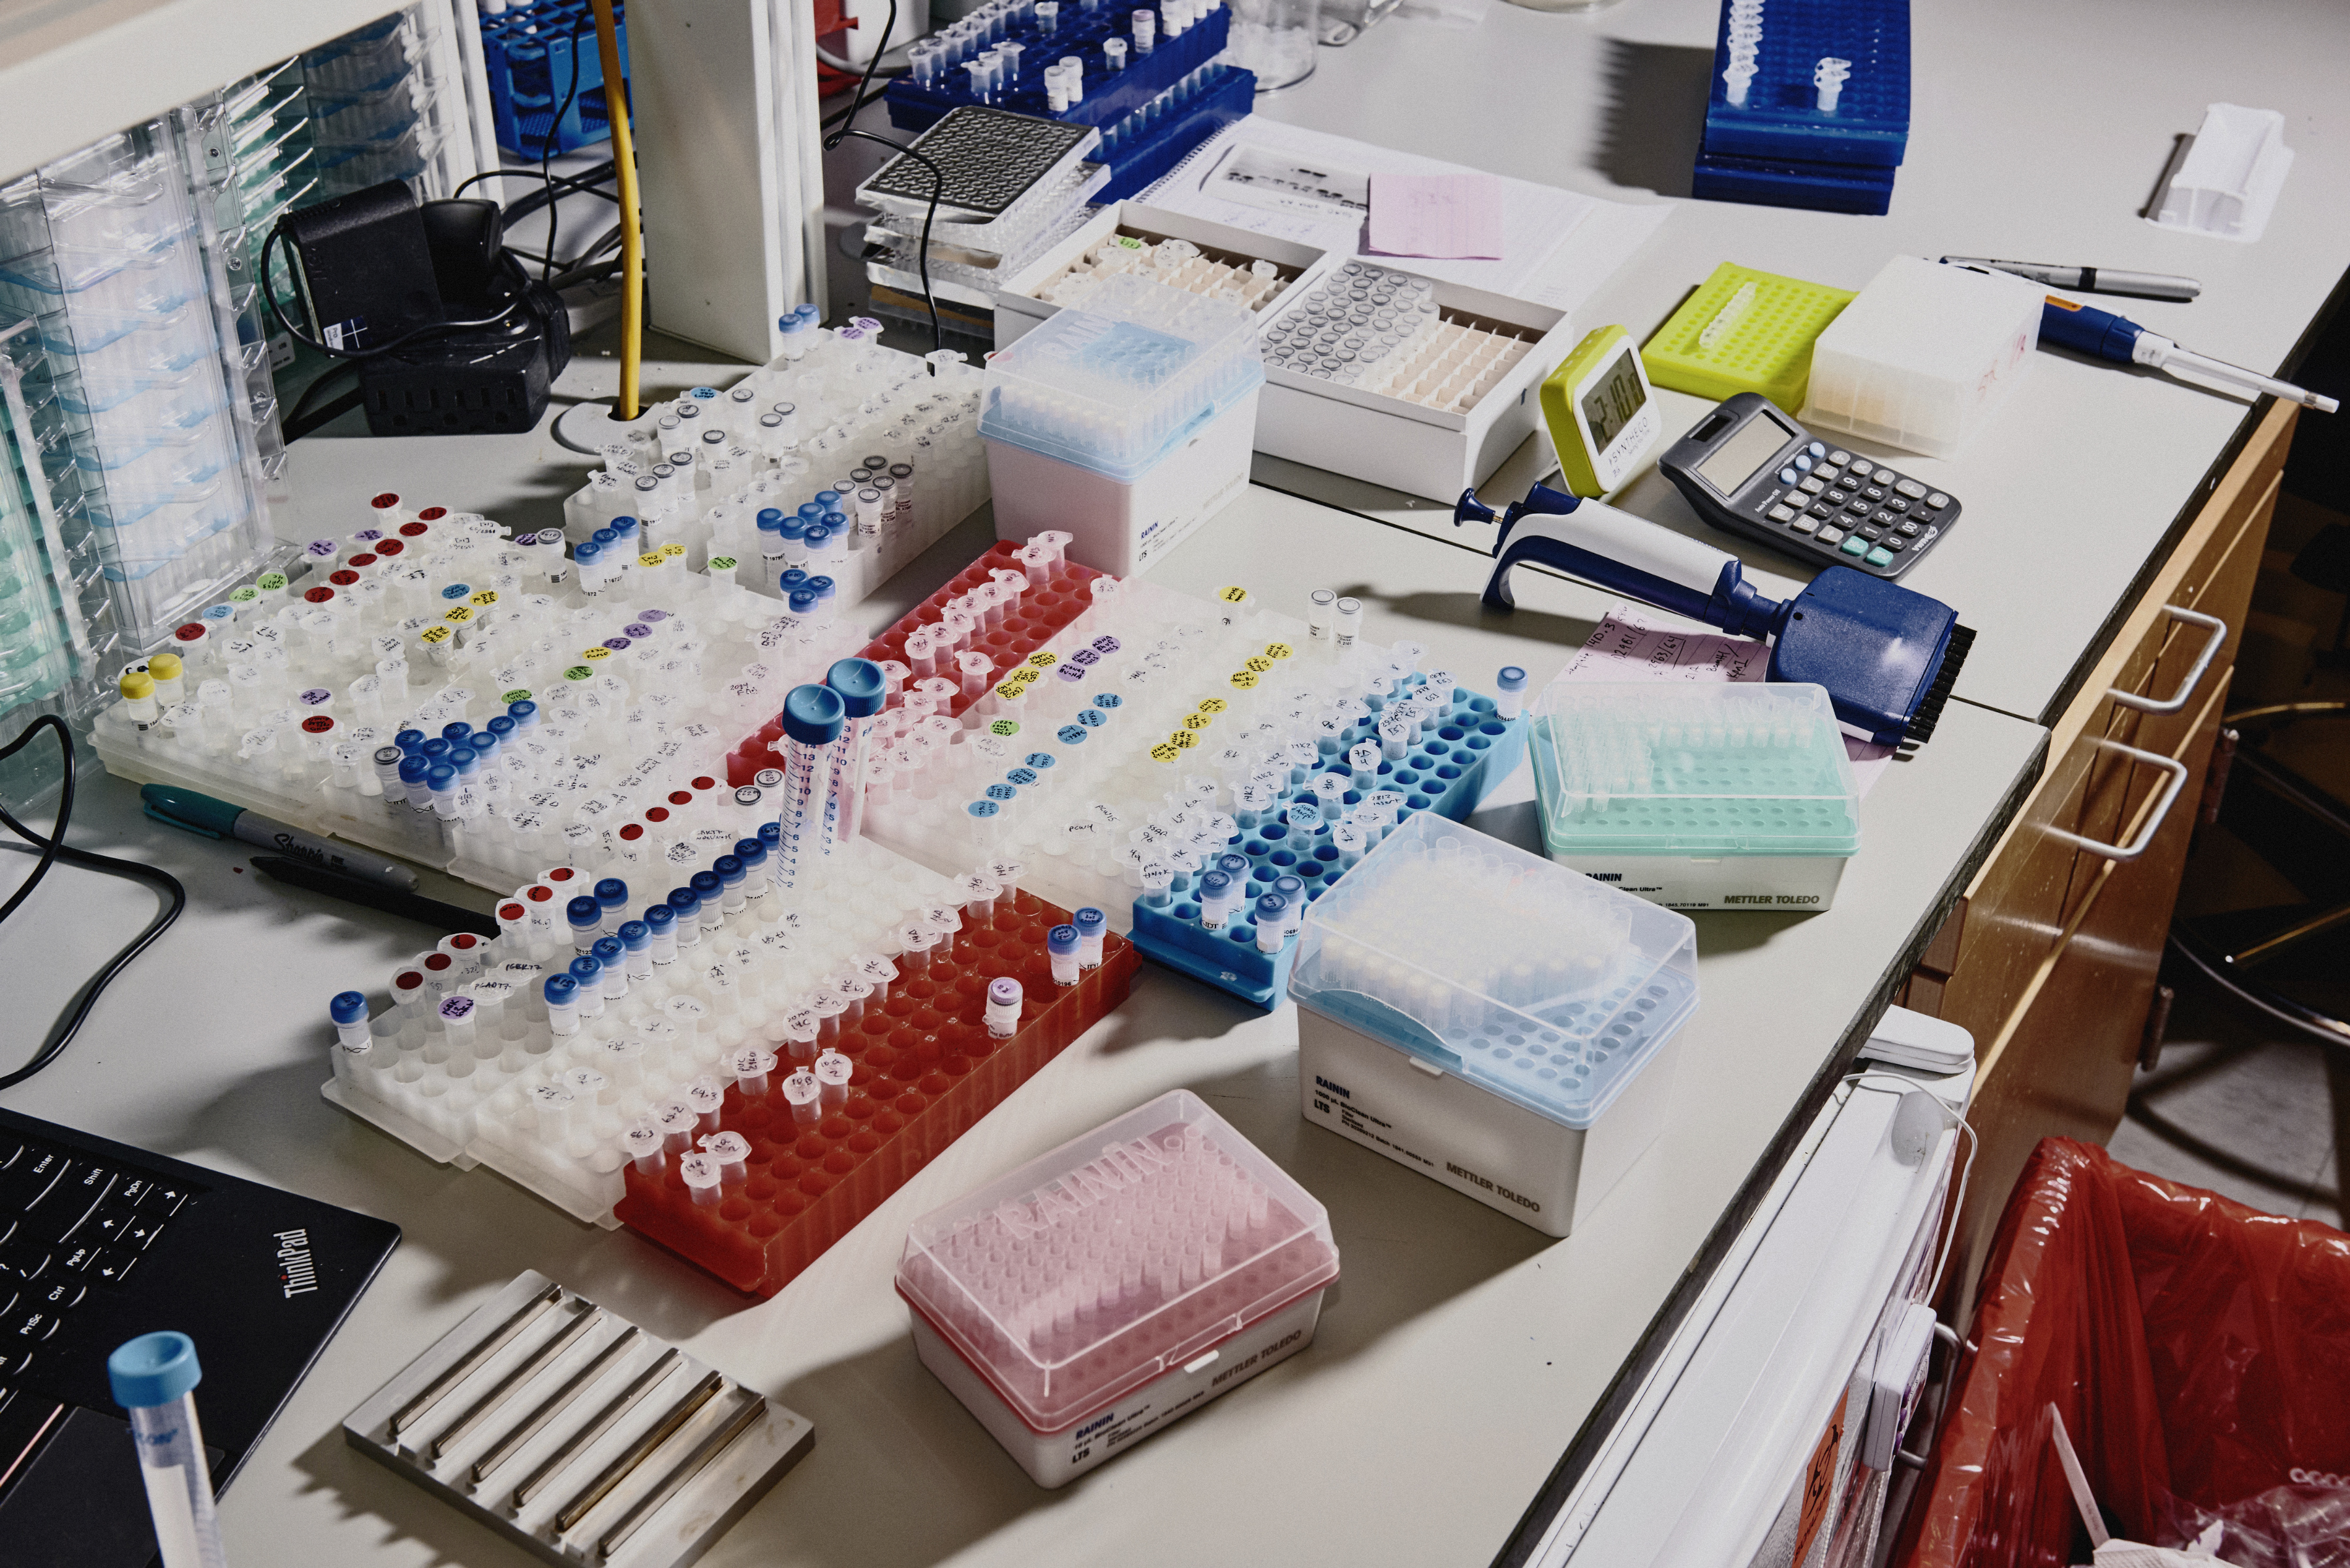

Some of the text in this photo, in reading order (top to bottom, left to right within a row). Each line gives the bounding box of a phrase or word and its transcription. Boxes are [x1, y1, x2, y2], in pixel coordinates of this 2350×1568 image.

[1612, 417, 1648, 463] SYNTHEGO
[1843, 477, 1858, 486] 9
[1829, 490, 1843, 500] 8
[1867, 487, 1882, 496] 6
[1755, 503, 1765, 513] Auto
[1762, 494, 1776, 507] Power
[1813, 503, 1827, 514] 7
[1853, 501, 1868, 510] 5
[1892, 498, 1906, 507] 3
[1840, 515, 1853, 524] 4
[1878, 512, 1893, 522] 2
[1141, 520, 1159, 540] RAININ
[1864, 526, 1878, 535] 1
[1902, 521, 1918, 533] 00
[1888, 537, 1902, 546] 0
[1139, 550, 1148, 562] LTS
[836, 757, 847, 766] 10
[1724, 895, 1820, 905] METTLER TOLEDO
[1315, 1075, 1350, 1099] RAININ
[1314, 1098, 1330, 1114] LTS
[1315, 1090, 1330, 1101] 1000
[1340, 1101, 1369, 1120] BioClean
[1375, 1135, 1391, 1147] Batch
[33, 1154, 54, 1174] Enter
[84, 1168, 103, 1185] Shift
[124, 1180, 142, 1197] PgDn
[992, 1137, 1175, 1240] RAININ
[1445, 1161, 1541, 1213] METTLER TOLEDO
[67, 1261, 86, 1279] PgUp
[273, 1228, 319, 1299] ThinkPad
[48, 1285, 65, 1301] Ctrl
[20, 1313, 43, 1335] PrtSc
[1212, 1329, 1302, 1387] METTLER TOLEDO
[1076, 1413, 1114, 1441] RAININ
[1072, 1447, 1090, 1464] LTS
